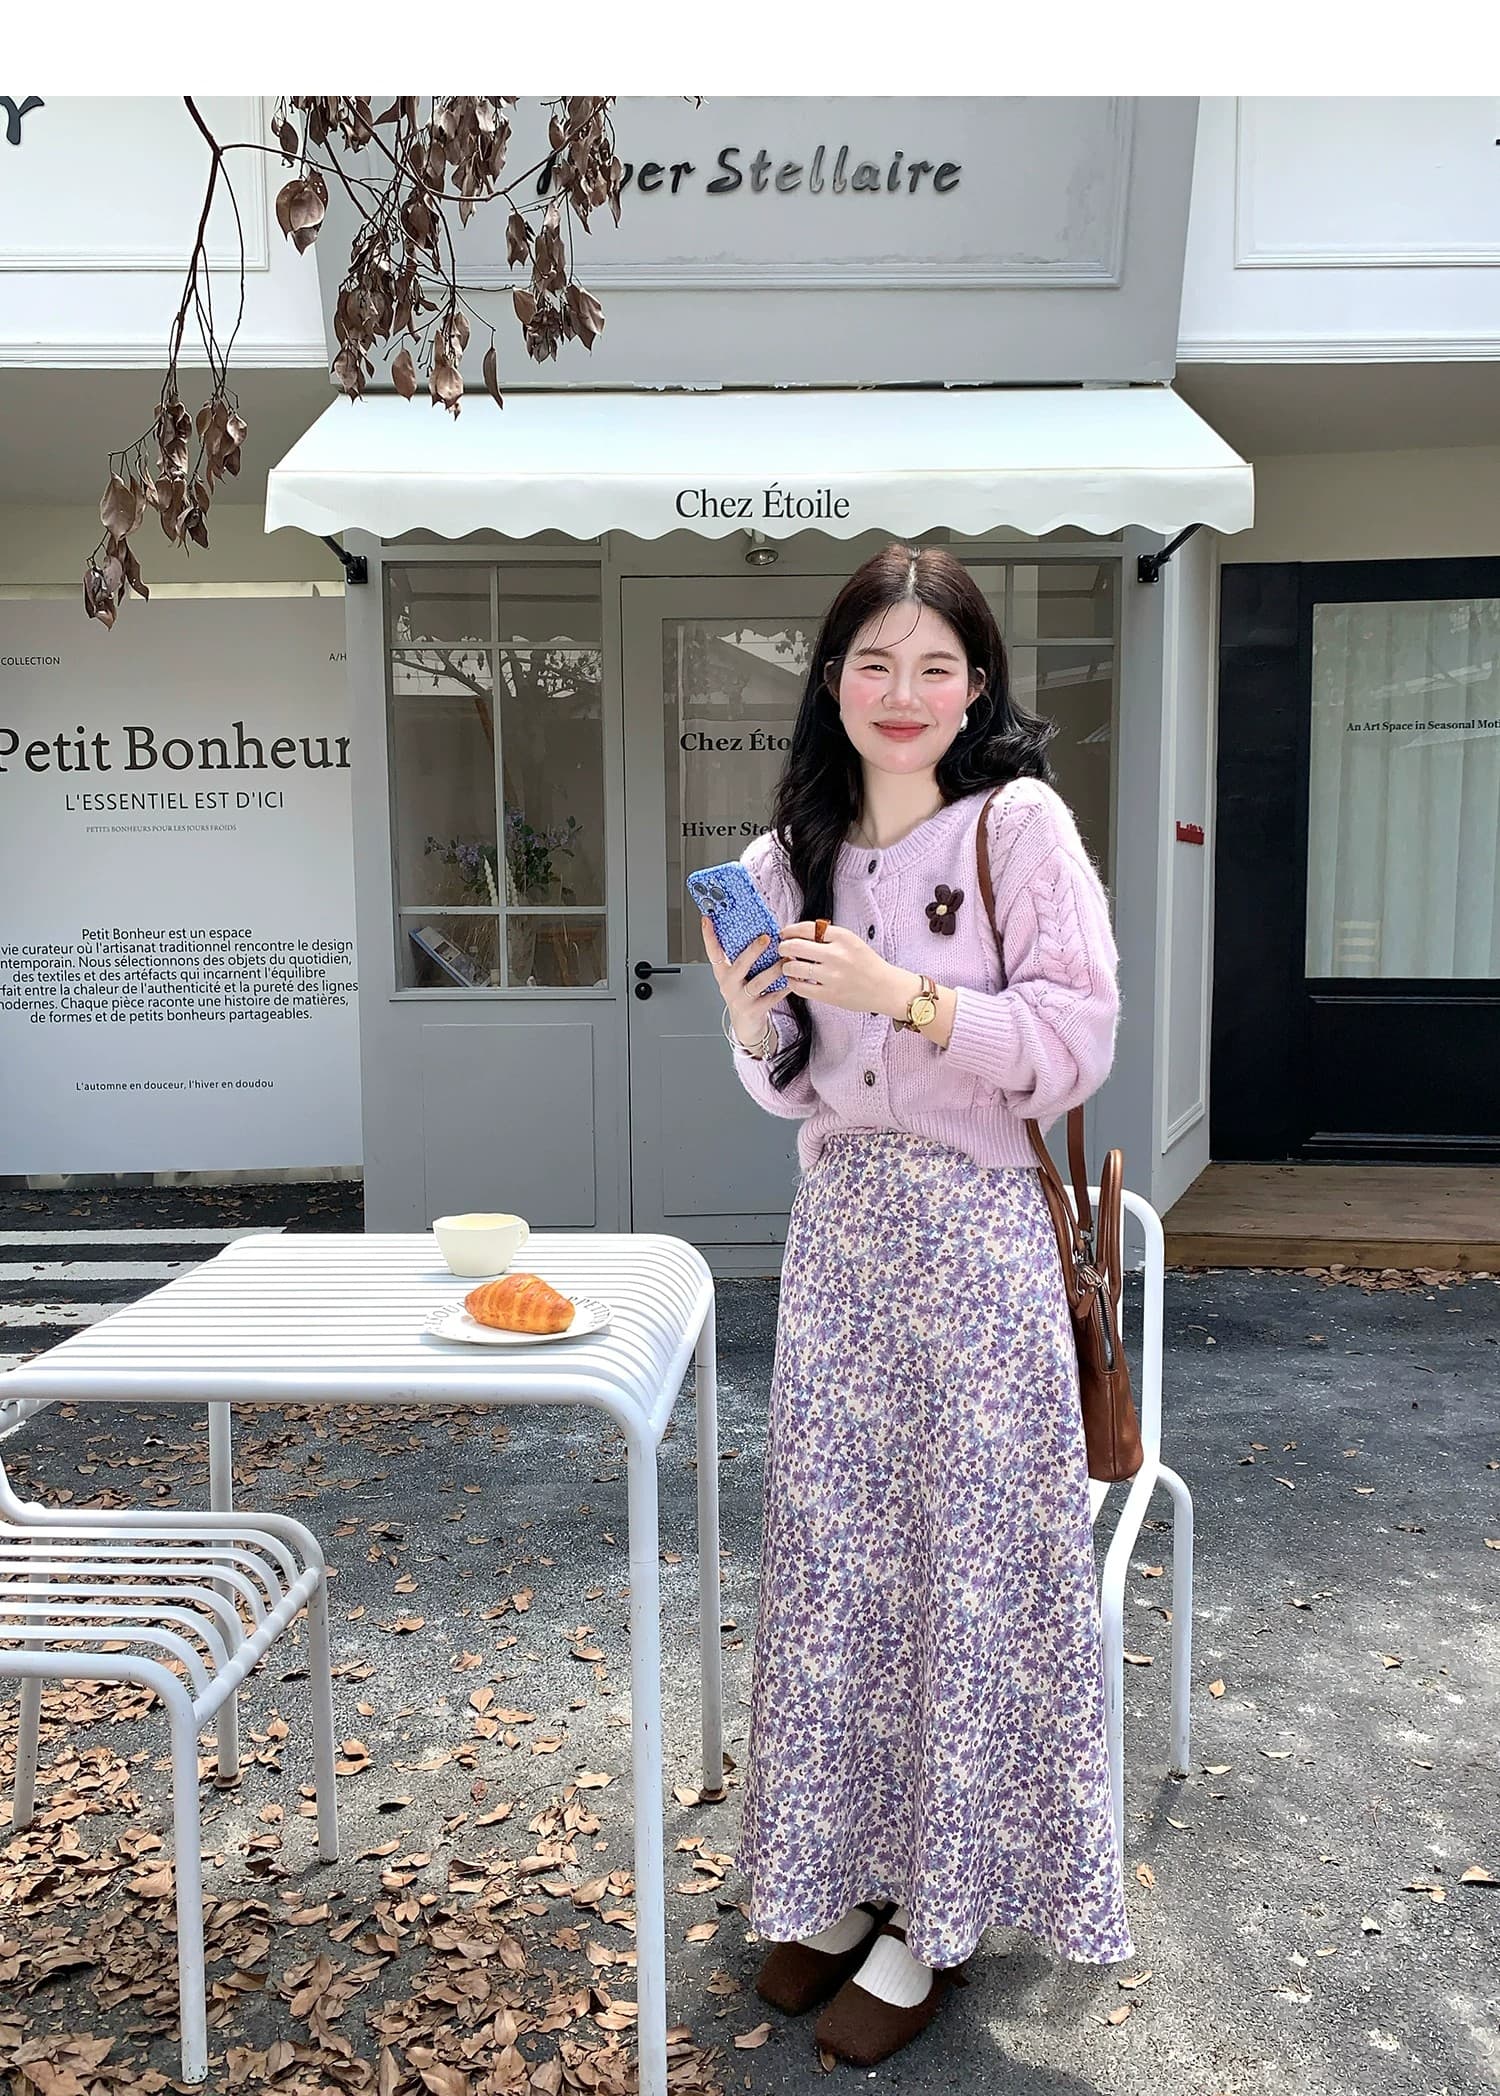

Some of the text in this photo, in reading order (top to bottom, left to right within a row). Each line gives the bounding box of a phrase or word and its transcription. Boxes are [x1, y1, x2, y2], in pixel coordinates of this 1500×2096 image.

[706, 145, 962, 194] Stellaire
[676, 481, 849, 518] Chez Étoile
[0, 656, 61, 666] COLLECTION
[329, 652, 347, 662] A/H
[1347, 722, 1361, 732] An
[1363, 722, 1380, 731] Art
[1382, 721, 1413, 733] Space
[1416, 720, 1426, 730] in
[1428, 719, 1475, 730] Seasonal
[0, 720, 351, 773] Petit Bonheur
[680, 732, 743, 751] Chez
[66, 791, 284, 811] L'ESSENTIEL EST D'ICI
[682, 822, 736, 837] Hiver
[82, 927, 252, 942] Petit Bonheur est un espace
[1, 938, 353, 955] vie curateur où l'artisanat traditionnel rencontre le design
[78, 956, 111, 968] Nous
[114, 954, 200, 968] sélectionnons
[203, 954, 224, 967] des
[228, 954, 266, 969] objets
[269, 953, 285, 966] du
[289, 953, 352, 968] quotidien,
[13, 966, 326, 983] des textiles et des artéfacts qui incarnent l'équilibre
[0, 979, 358, 996] fait entre la chaleur de l'authenticité et la pureté des lignes
[61, 997, 108, 1012] Chaque
[112, 996, 144, 1012] pièce
[148, 997, 194, 1008] raconte
[198, 999, 221, 1008] une
[225, 995, 270, 1008] histoire
[273, 995, 289, 1007] de
[293, 994, 349, 1008] matières,
[30, 1007, 312, 1025] de formes et de petits bonheurs partageables.
[76, 1078, 274, 1092] L'automne en douceur, l'hiver en doudou
